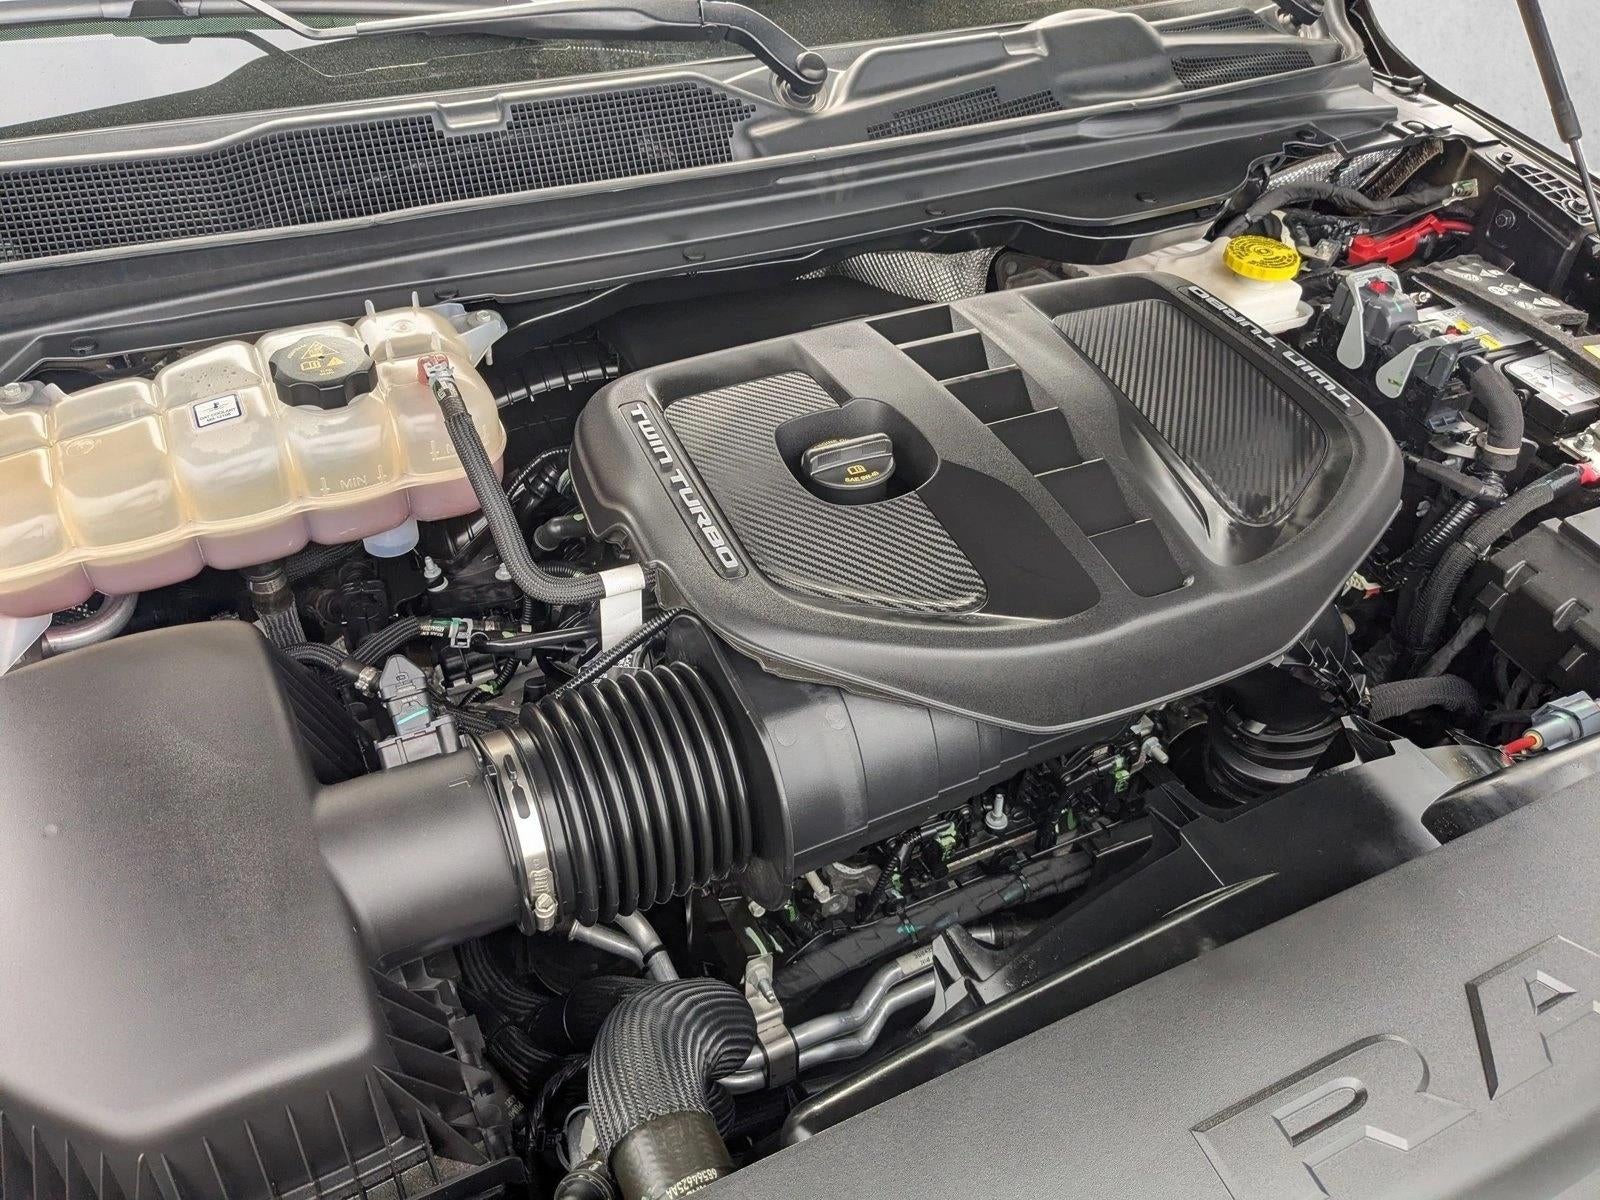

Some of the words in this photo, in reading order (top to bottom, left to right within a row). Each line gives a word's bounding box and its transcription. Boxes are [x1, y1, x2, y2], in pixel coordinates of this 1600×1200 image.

[1187, 286, 1277, 348] TURBO
[1282, 350, 1351, 408] TWIN
[339, 474, 368, 491] MIN
[630, 403, 673, 470] TWIN
[669, 468, 739, 573] TURBO
